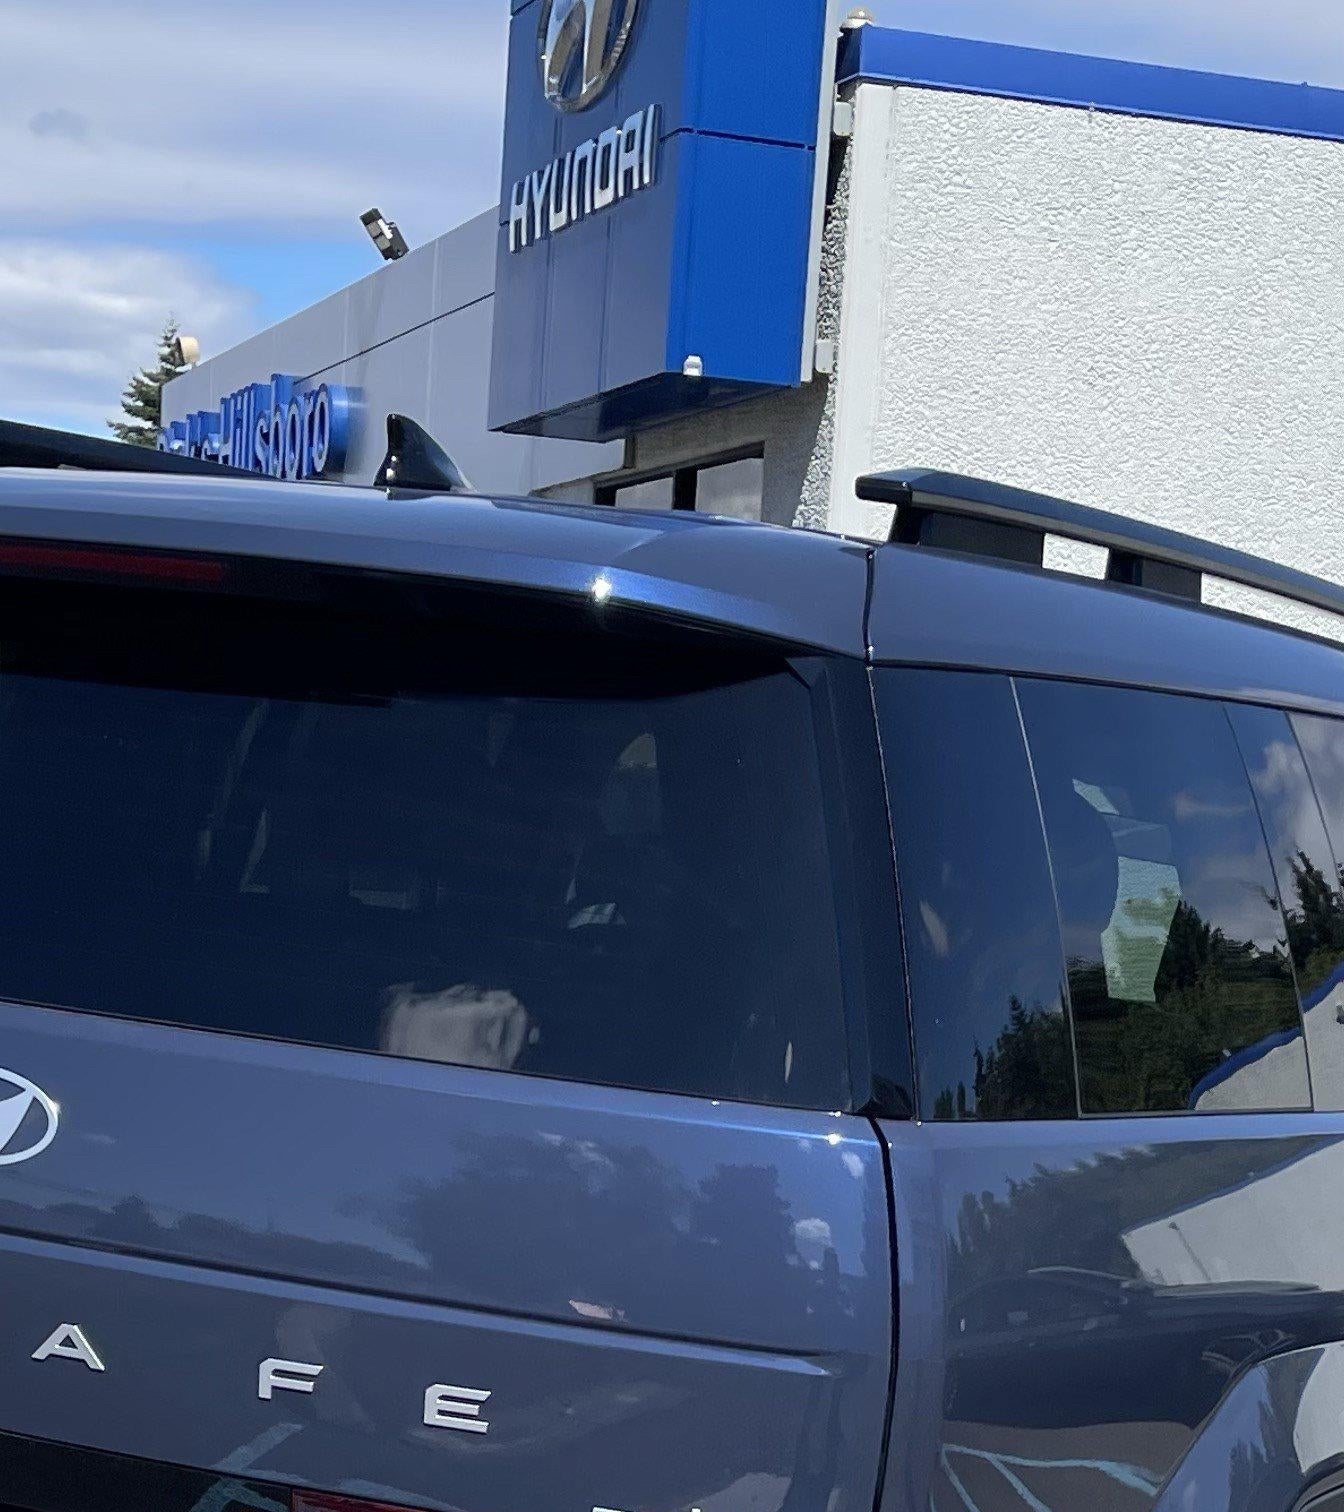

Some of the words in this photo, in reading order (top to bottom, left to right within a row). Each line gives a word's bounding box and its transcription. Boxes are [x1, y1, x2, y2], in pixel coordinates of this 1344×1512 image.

[509, 104, 658, 252] HYUNDAI
[220, 373, 330, 480] Hillsboro
[258, 1357, 492, 1434] FE
